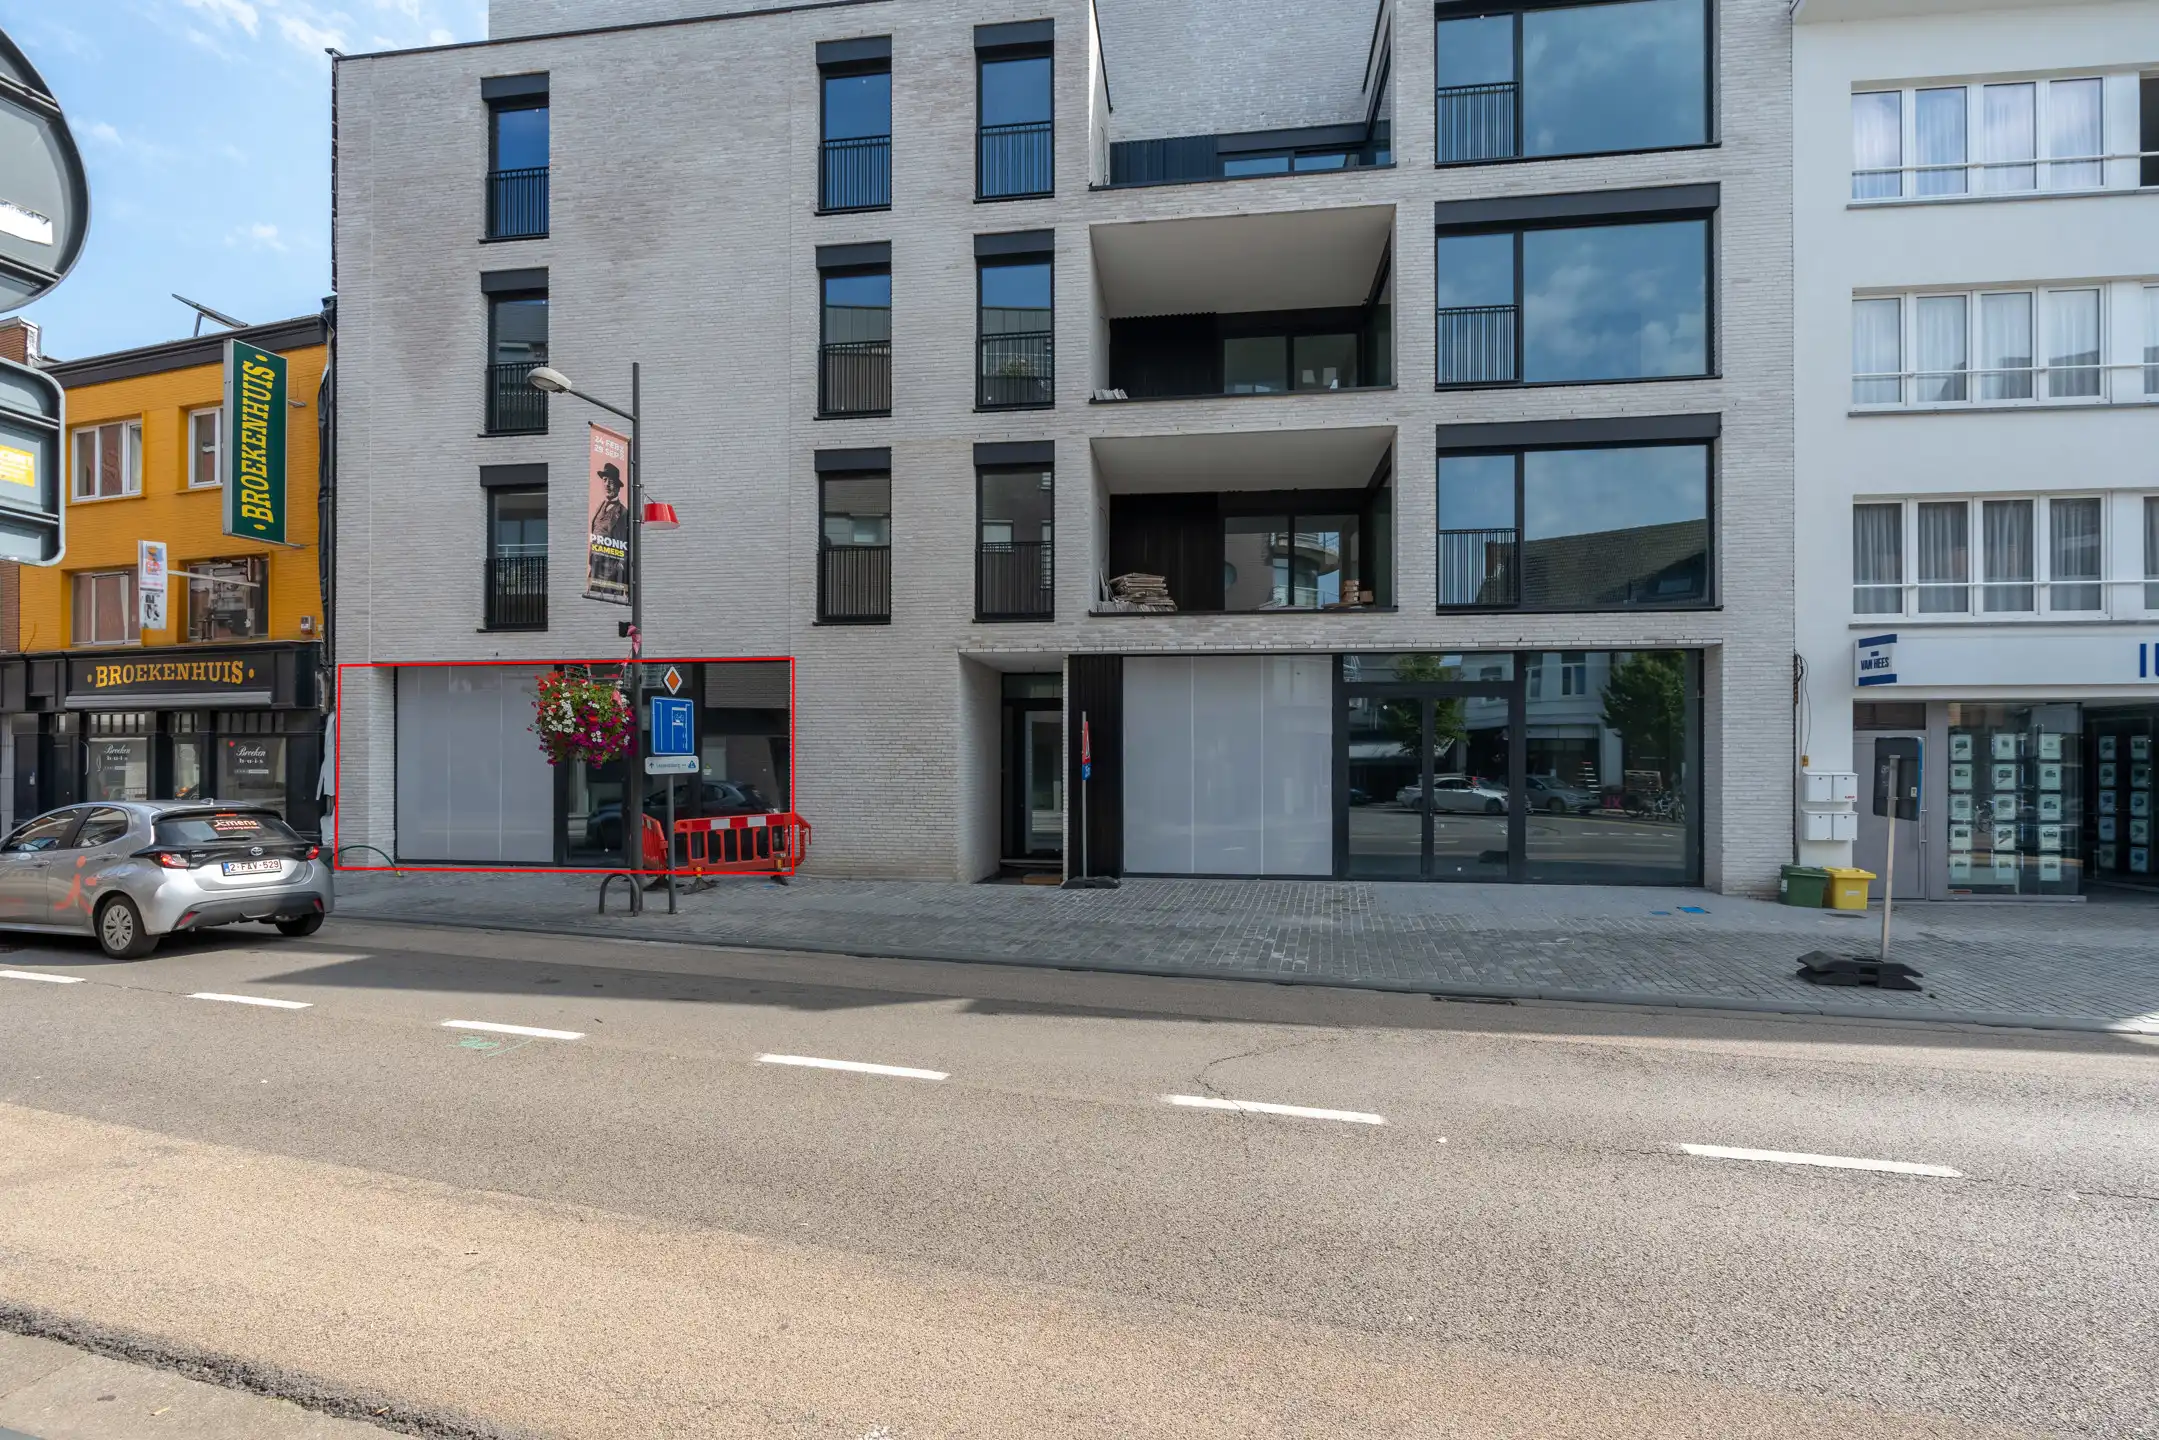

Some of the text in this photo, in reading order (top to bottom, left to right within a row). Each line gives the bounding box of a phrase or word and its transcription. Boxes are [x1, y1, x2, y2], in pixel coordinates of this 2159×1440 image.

[241, 360, 276, 524] BROEKENHUIS
[590, 533, 628, 551] PRONK
[592, 543, 625, 558] KAMERS
[1861, 656, 1890, 670] VAN HEES
[95, 660, 244, 688] BROEKENHUIS
